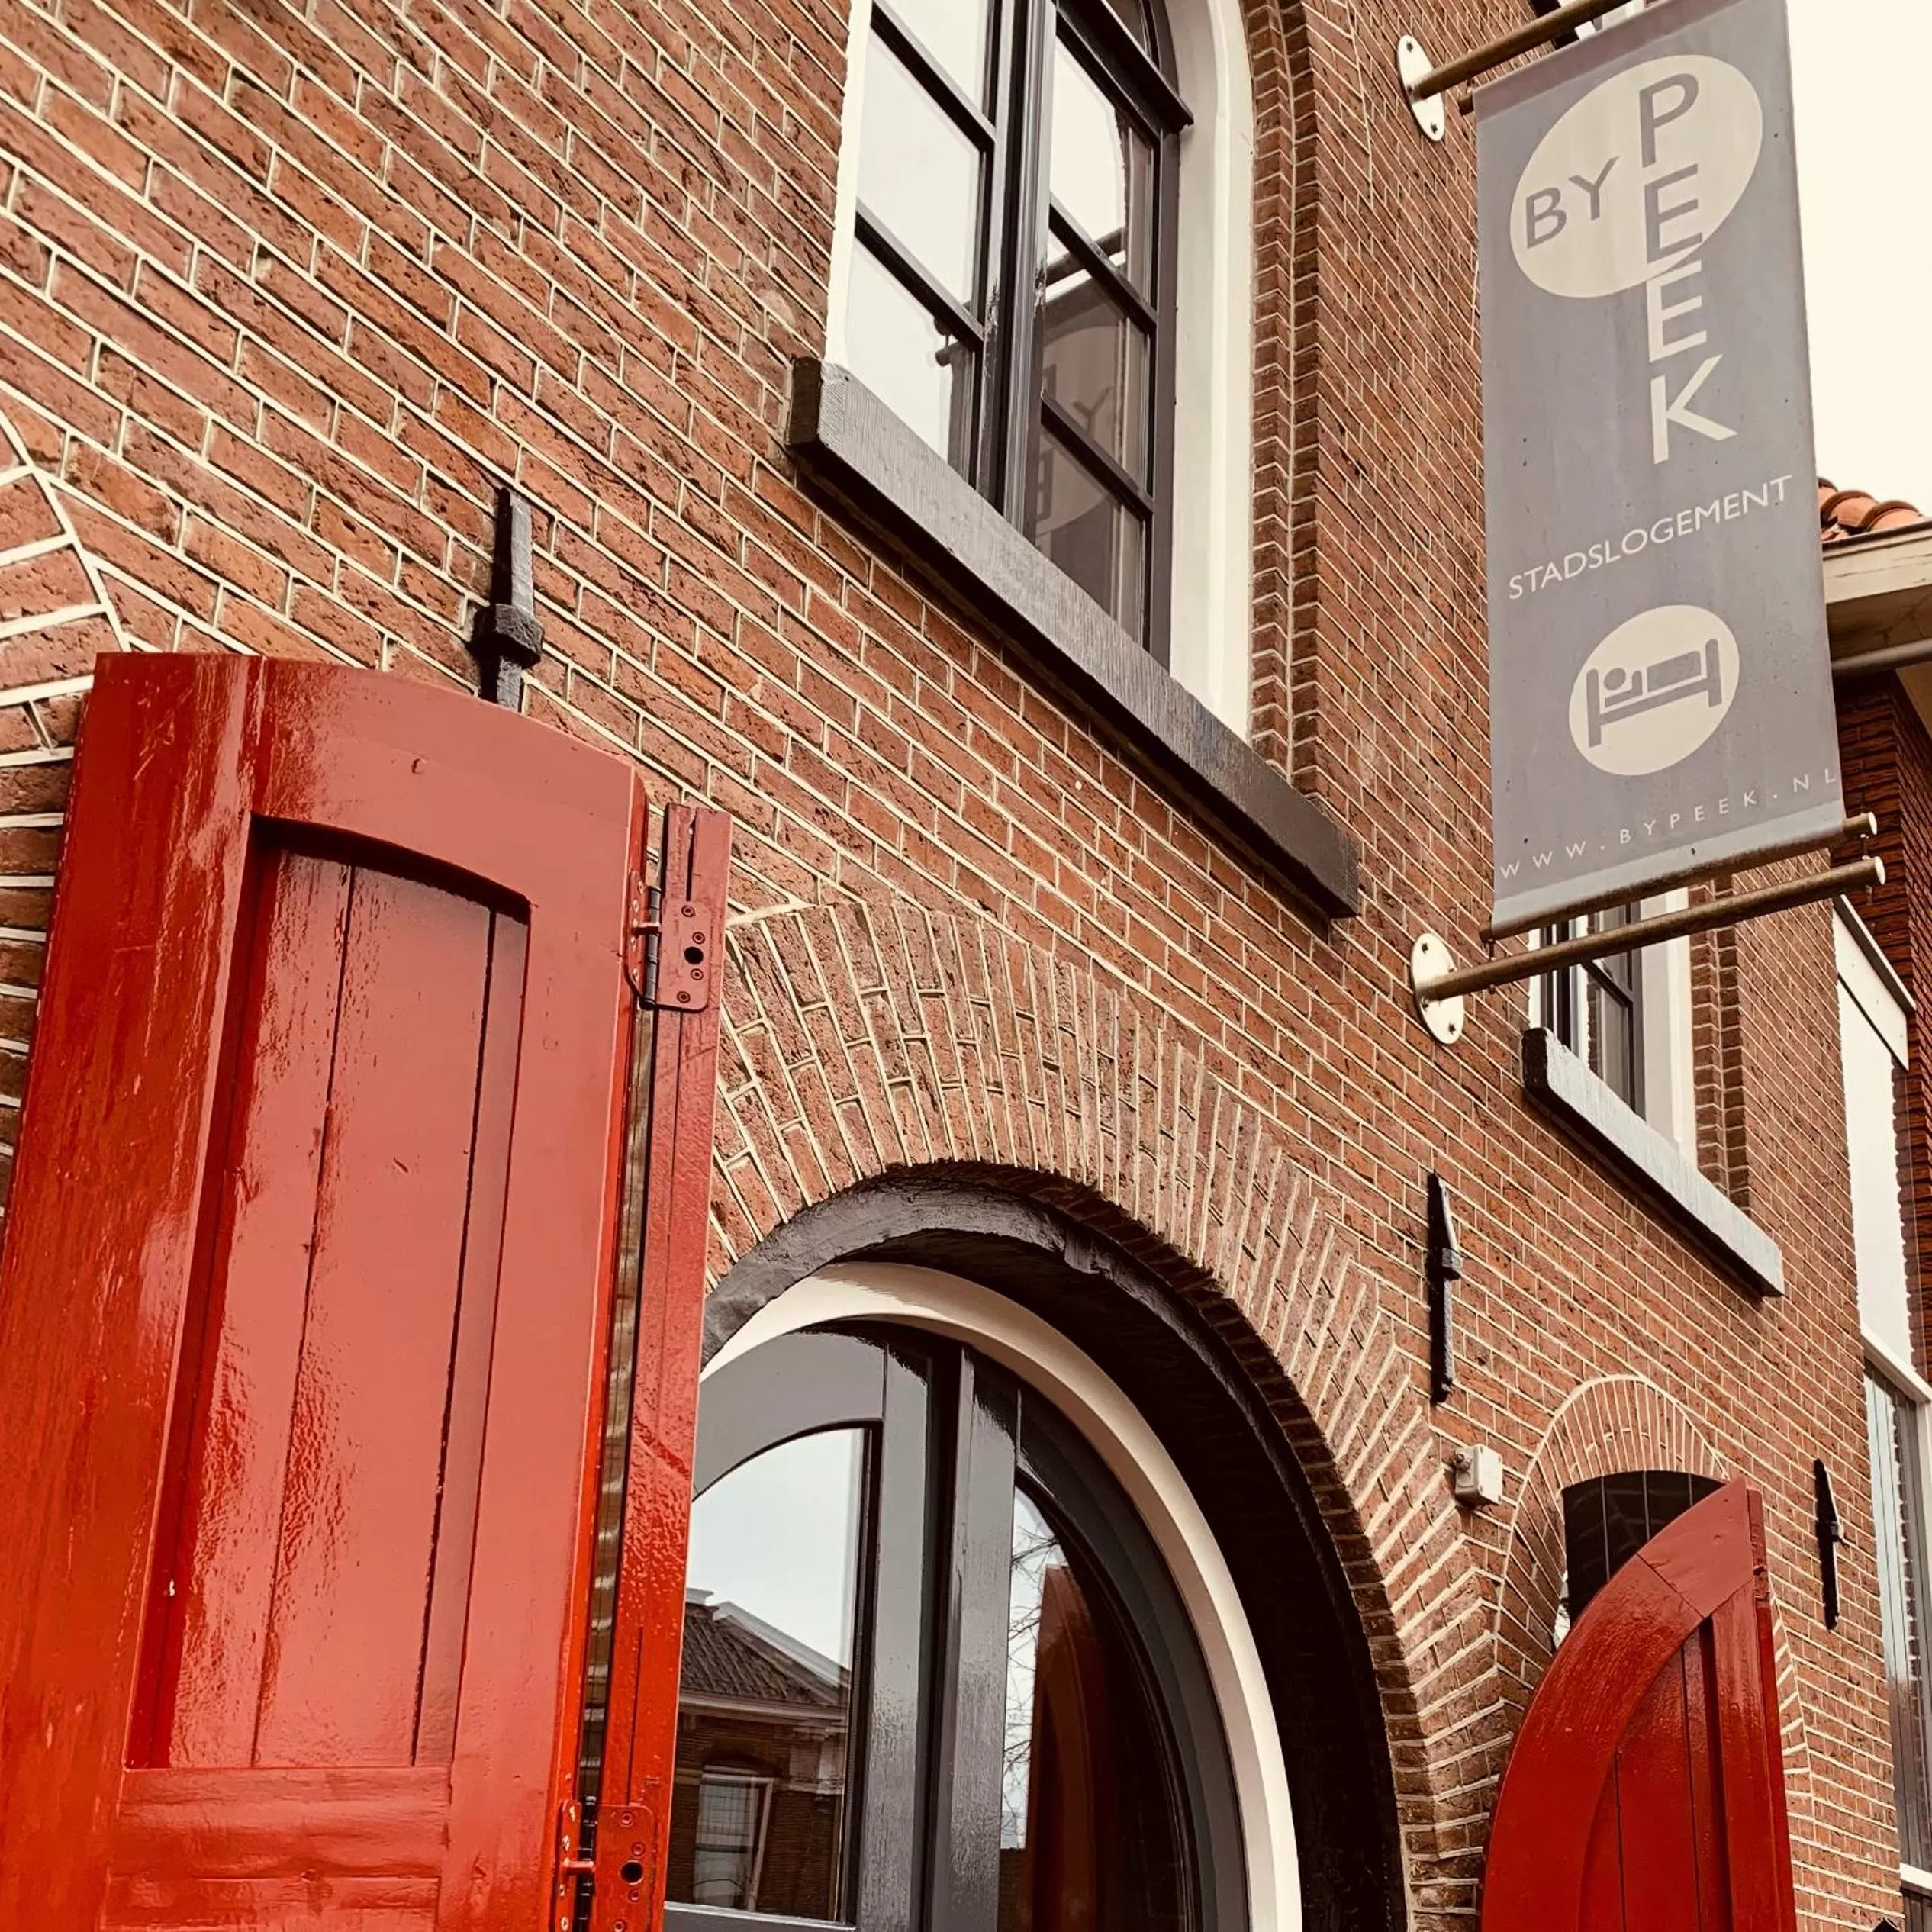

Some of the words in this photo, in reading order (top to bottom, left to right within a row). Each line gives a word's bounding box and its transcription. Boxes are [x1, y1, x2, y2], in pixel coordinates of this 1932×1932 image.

[1525, 156, 1621, 250] BY
[1639, 73, 1738, 464] PEEK
[1509, 475, 1792, 600] STADSLOGEMENT
[1500, 769, 1837, 880] WWW.BYPEEK.NL
